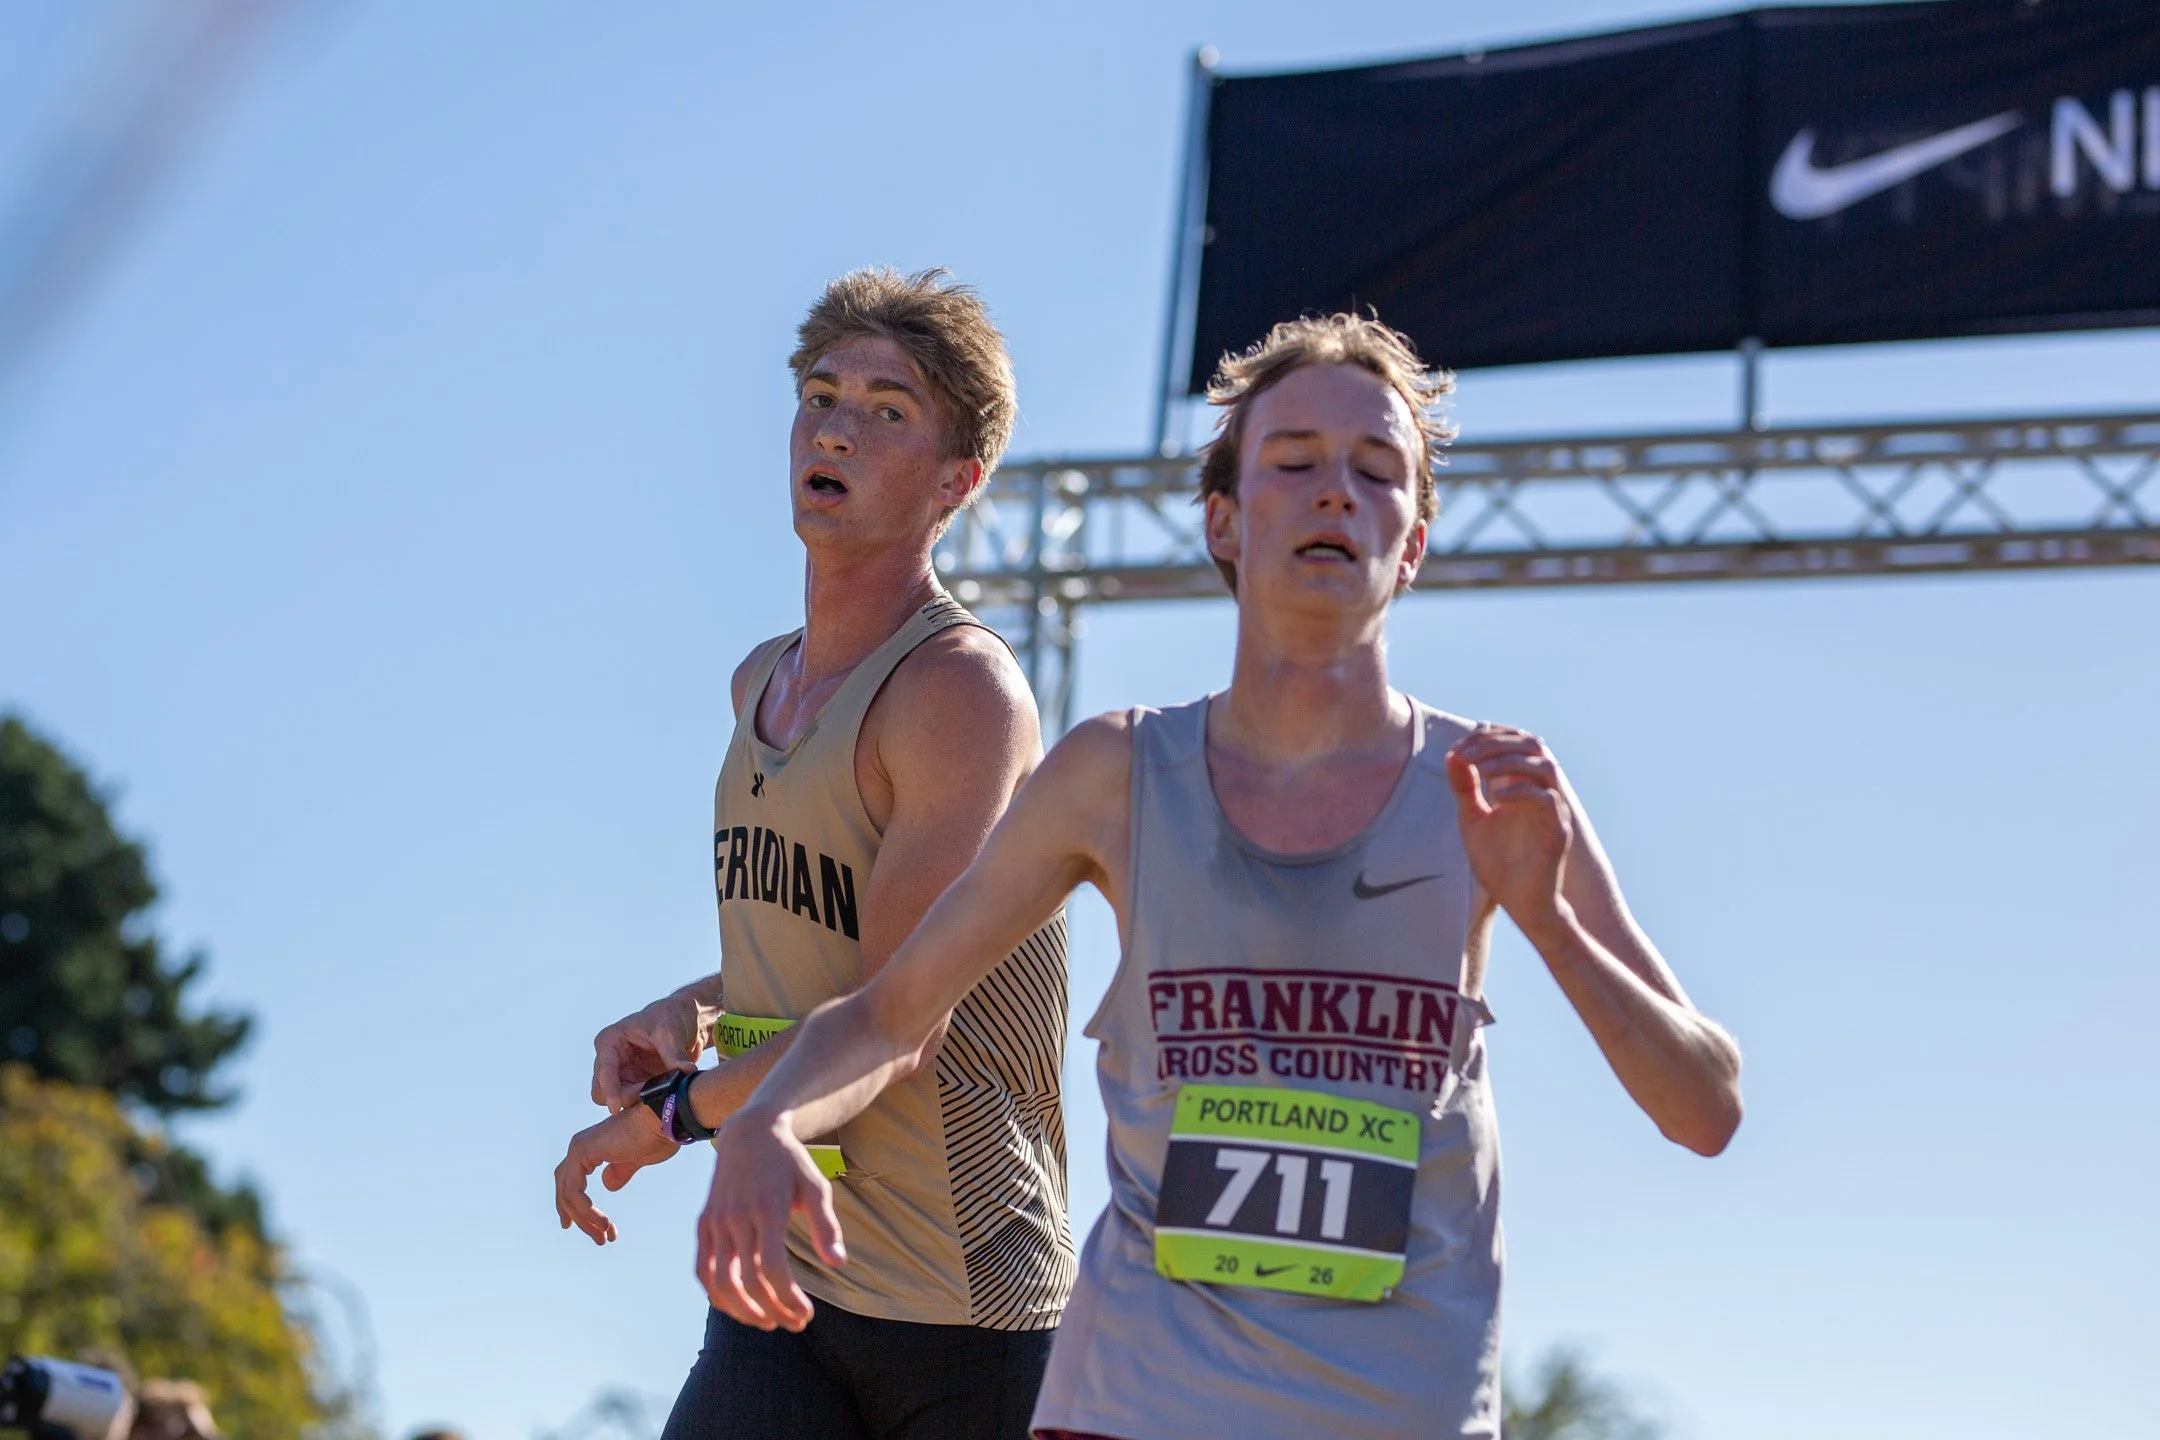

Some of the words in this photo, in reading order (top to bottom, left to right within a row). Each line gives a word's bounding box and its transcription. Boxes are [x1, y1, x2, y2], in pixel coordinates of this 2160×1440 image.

[1149, 980, 1458, 1046] FRANKLIN
[1200, 1098, 1349, 1133] PORTLAND
[1359, 1114, 1395, 1142] XC
[1205, 1148, 1354, 1240] 711
[1214, 1255, 1239, 1273] 20
[1309, 1266, 1333, 1285] 26
